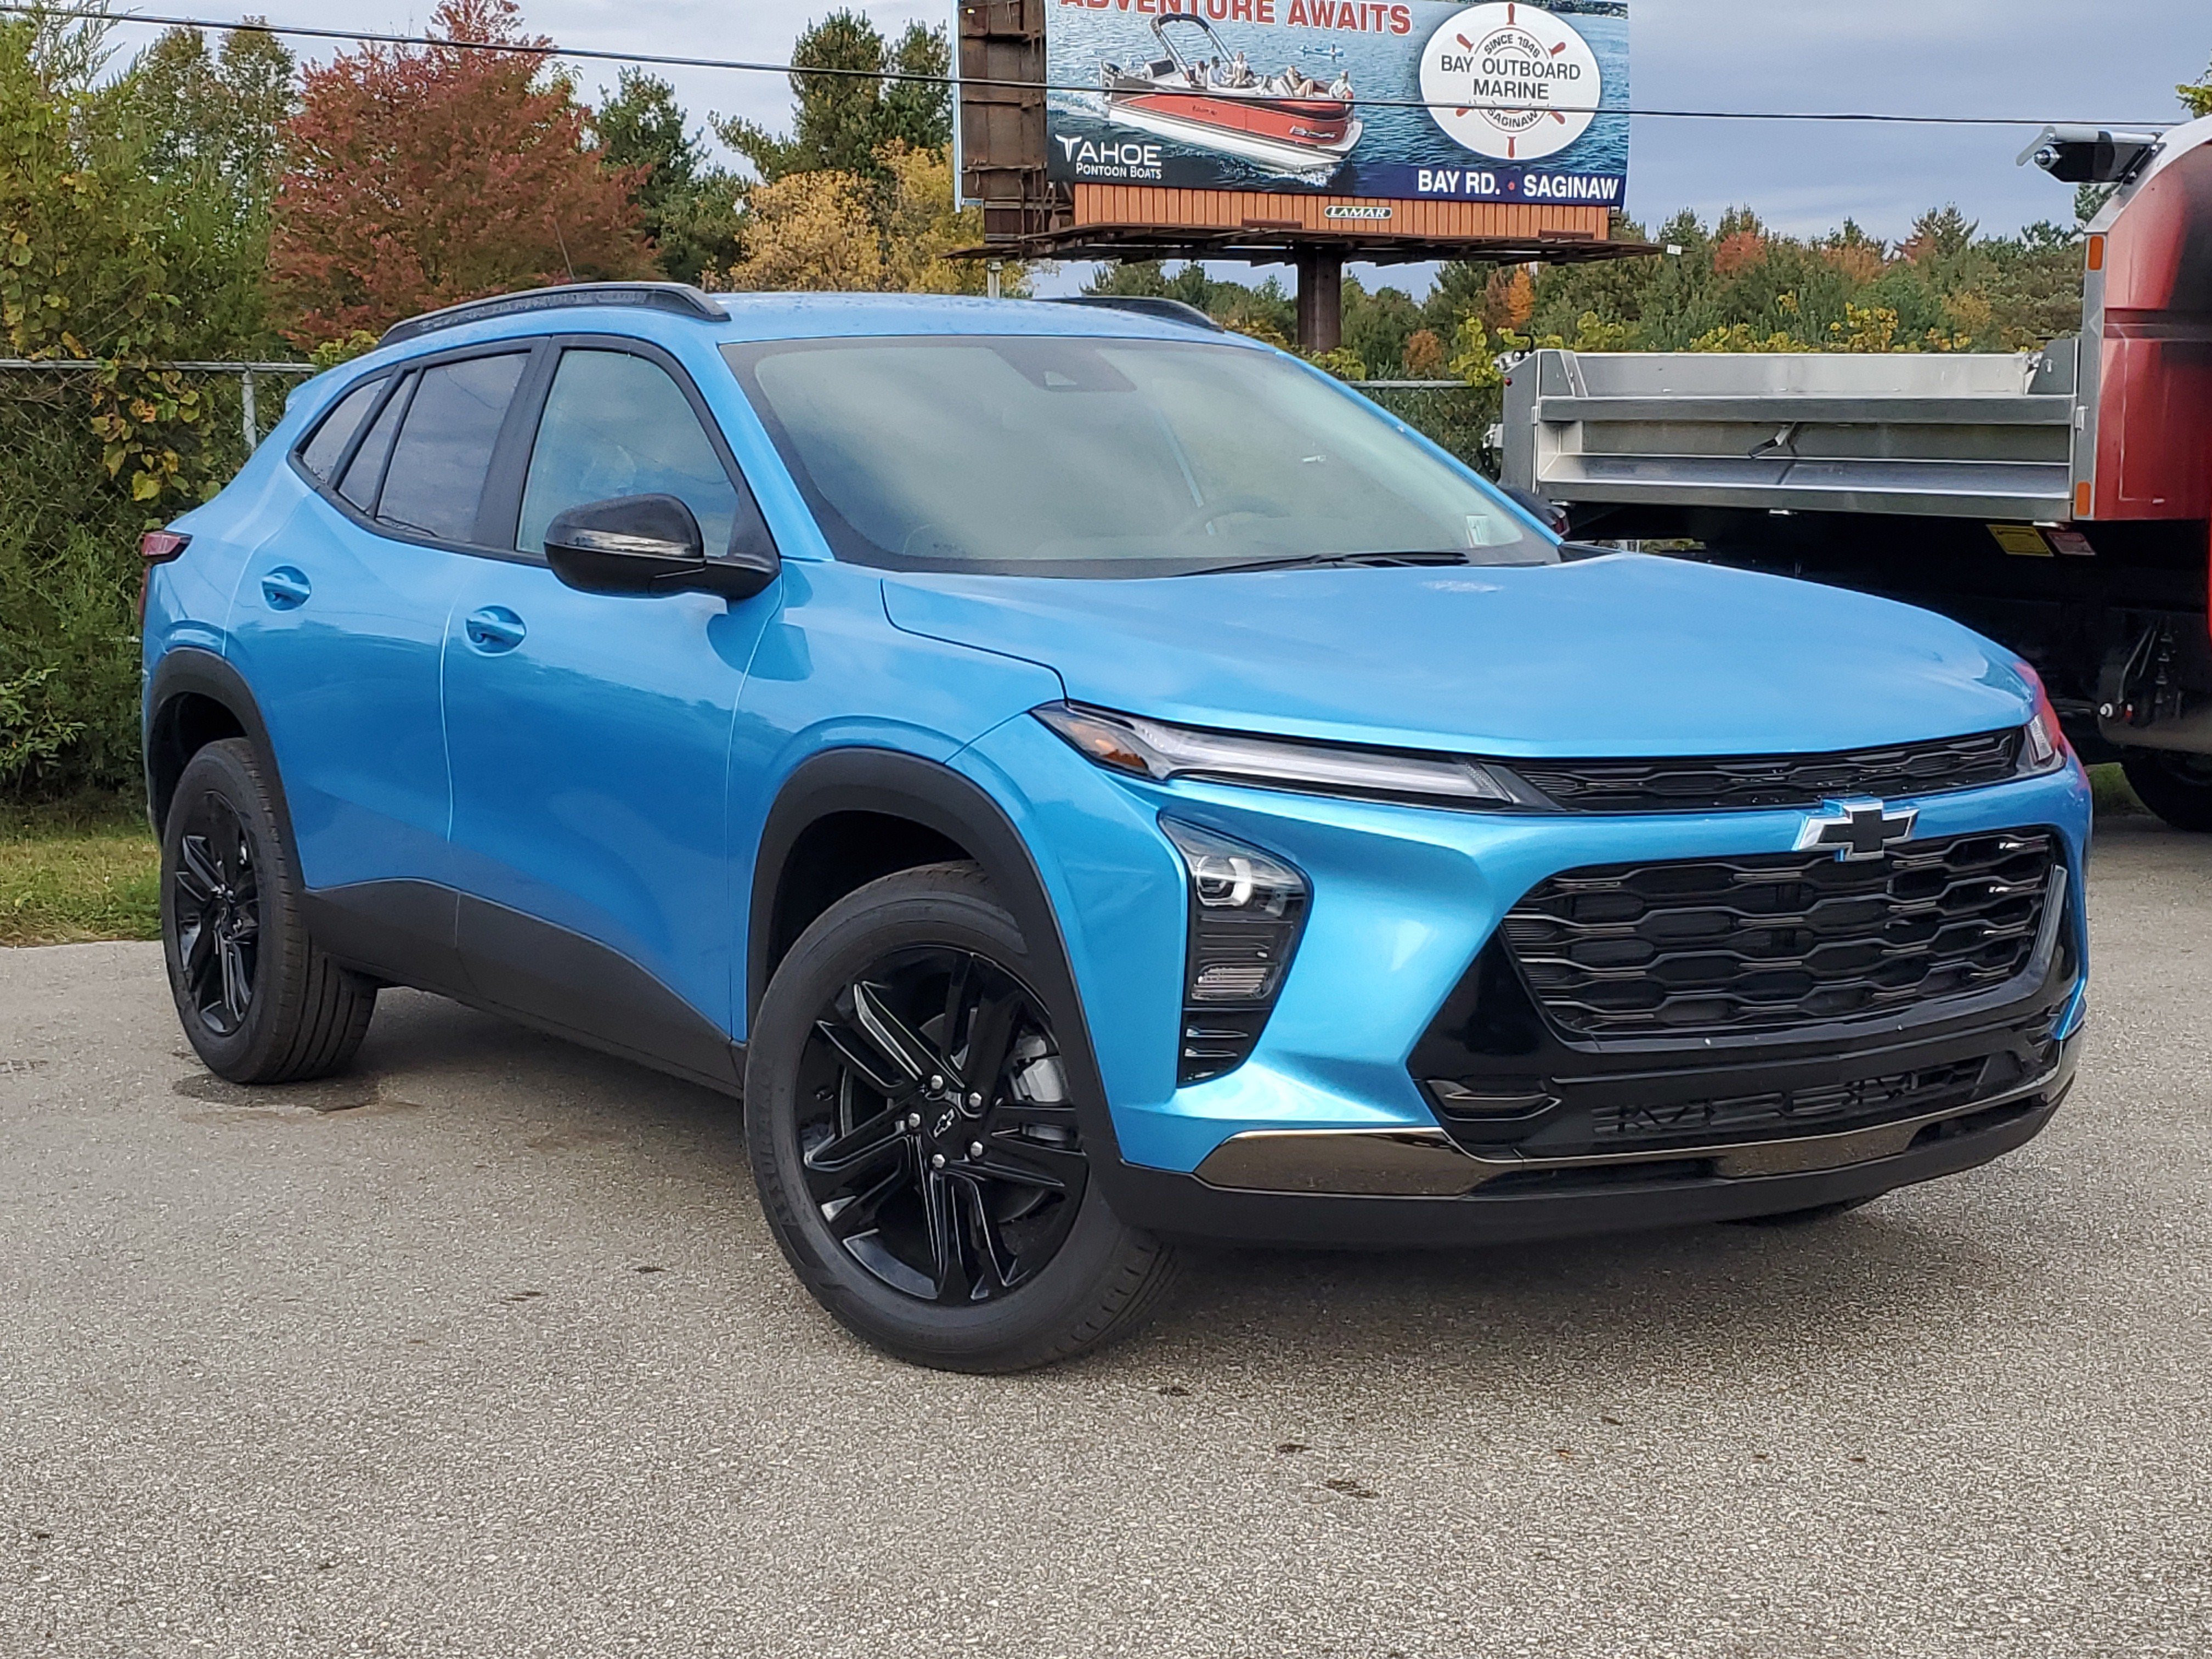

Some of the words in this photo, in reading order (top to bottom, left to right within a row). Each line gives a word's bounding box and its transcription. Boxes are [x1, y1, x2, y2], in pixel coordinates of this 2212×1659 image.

[1060, 0, 1275, 24] NTURE
[1288, 0, 1411, 35] AWAITS
[1484, 34, 1513, 55] SINCE
[1441, 55, 1474, 72] BAY
[1482, 58, 1581, 80] OUTBOARD
[1473, 78, 1549, 100] MARINE
[1487, 109, 1537, 128] SAGINAW
[1055, 134, 1162, 166] TAHOE
[1418, 170, 1459, 193] BAY
[1465, 172, 1500, 195] RD.
[1523, 174, 1618, 199] SAGINAW
[1330, 207, 1386, 217] LAMAR
